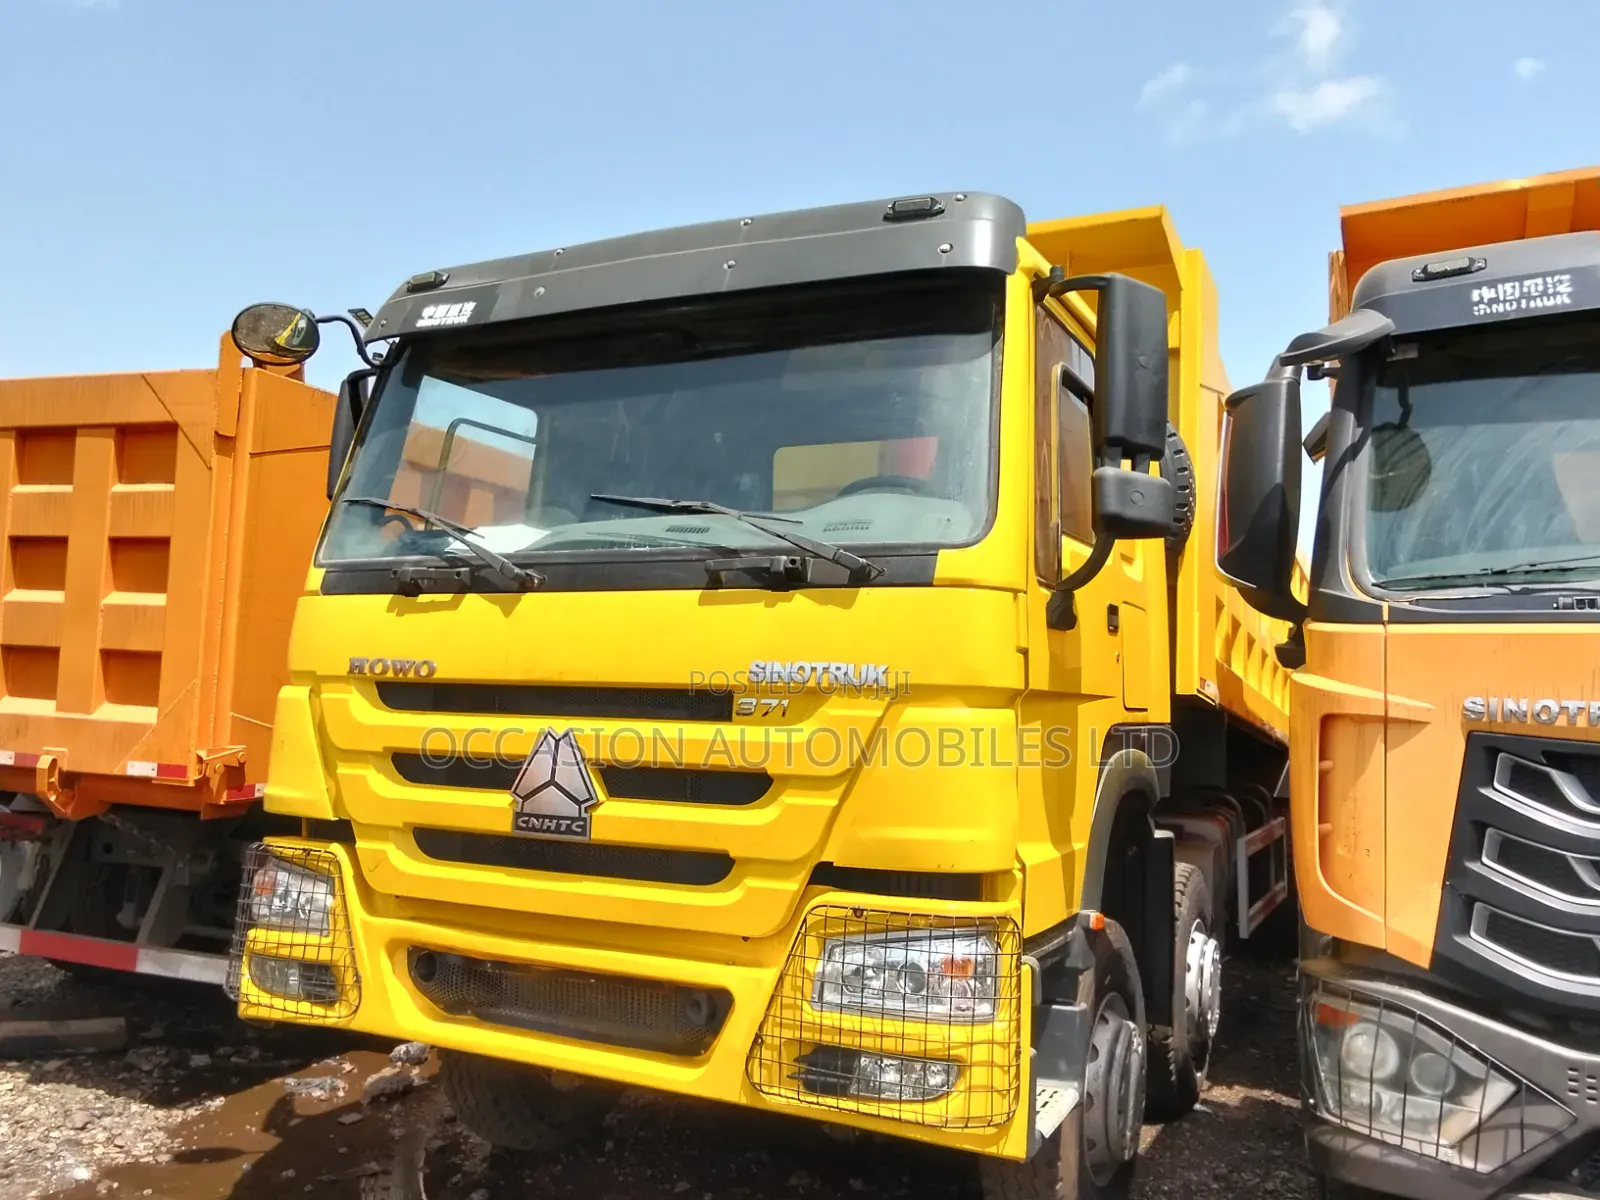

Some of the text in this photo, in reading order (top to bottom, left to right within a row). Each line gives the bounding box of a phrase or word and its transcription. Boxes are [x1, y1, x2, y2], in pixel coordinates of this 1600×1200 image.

[347, 657, 437, 678] HOWO
[749, 660, 889, 687] SINOTRUK
[735, 697, 790, 718] 371
[517, 816, 585, 832] CNHTC
